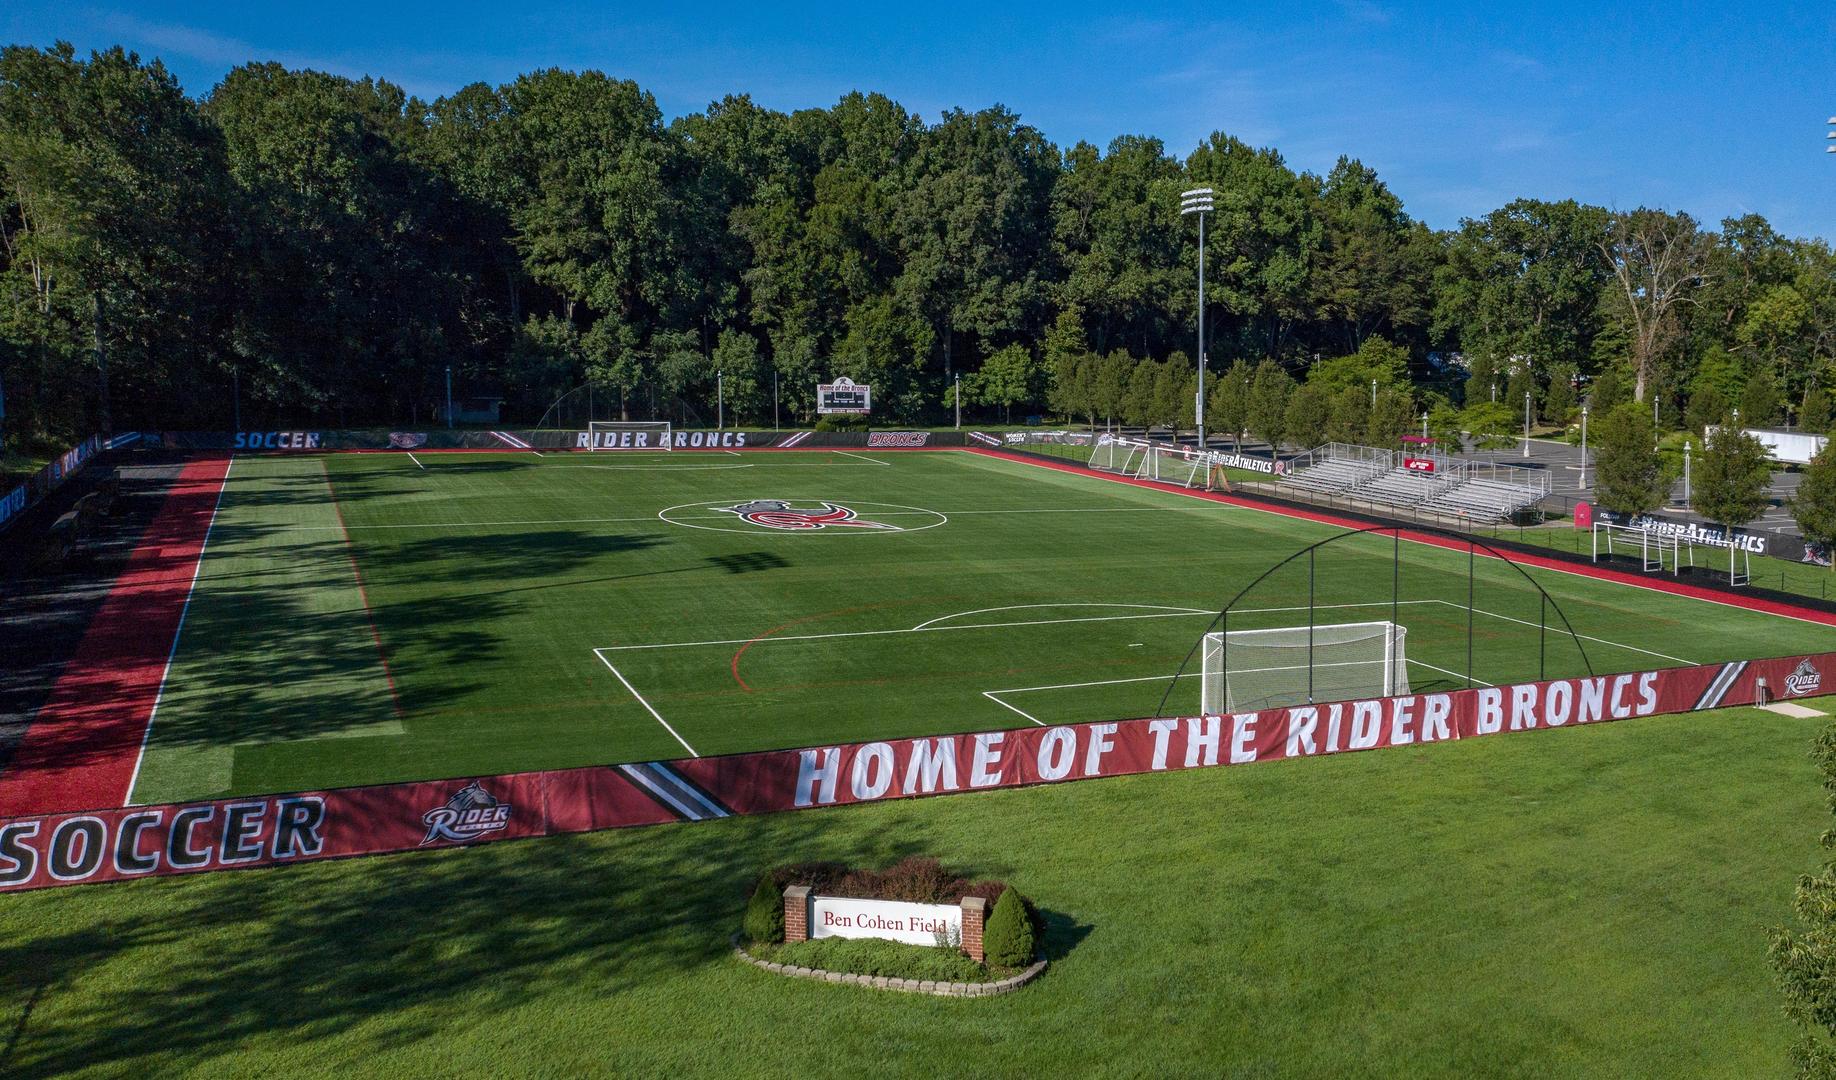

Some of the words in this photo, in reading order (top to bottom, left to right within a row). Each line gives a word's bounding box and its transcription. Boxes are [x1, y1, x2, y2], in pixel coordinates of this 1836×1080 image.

[234, 432, 320, 448] SOCCER
[576, 432, 647, 448] RIDER
[659, 432, 745, 448] BRONCS
[867, 432, 928, 447] BRONCS
[1784, 672, 1820, 696] RIDER
[794, 732, 1003, 807] HOME
[1037, 723, 1117, 781] OF
[1148, 713, 1258, 770] THE
[1286, 694, 1451, 756] RIDER
[1477, 671, 1658, 734] BRONCS
[421, 804, 511, 844] RIDER
[0, 796, 325, 887] SOCCER
[823, 911, 851, 927] Ben
[856, 913, 904, 931] Cohen
[909, 917, 946, 934] Field
